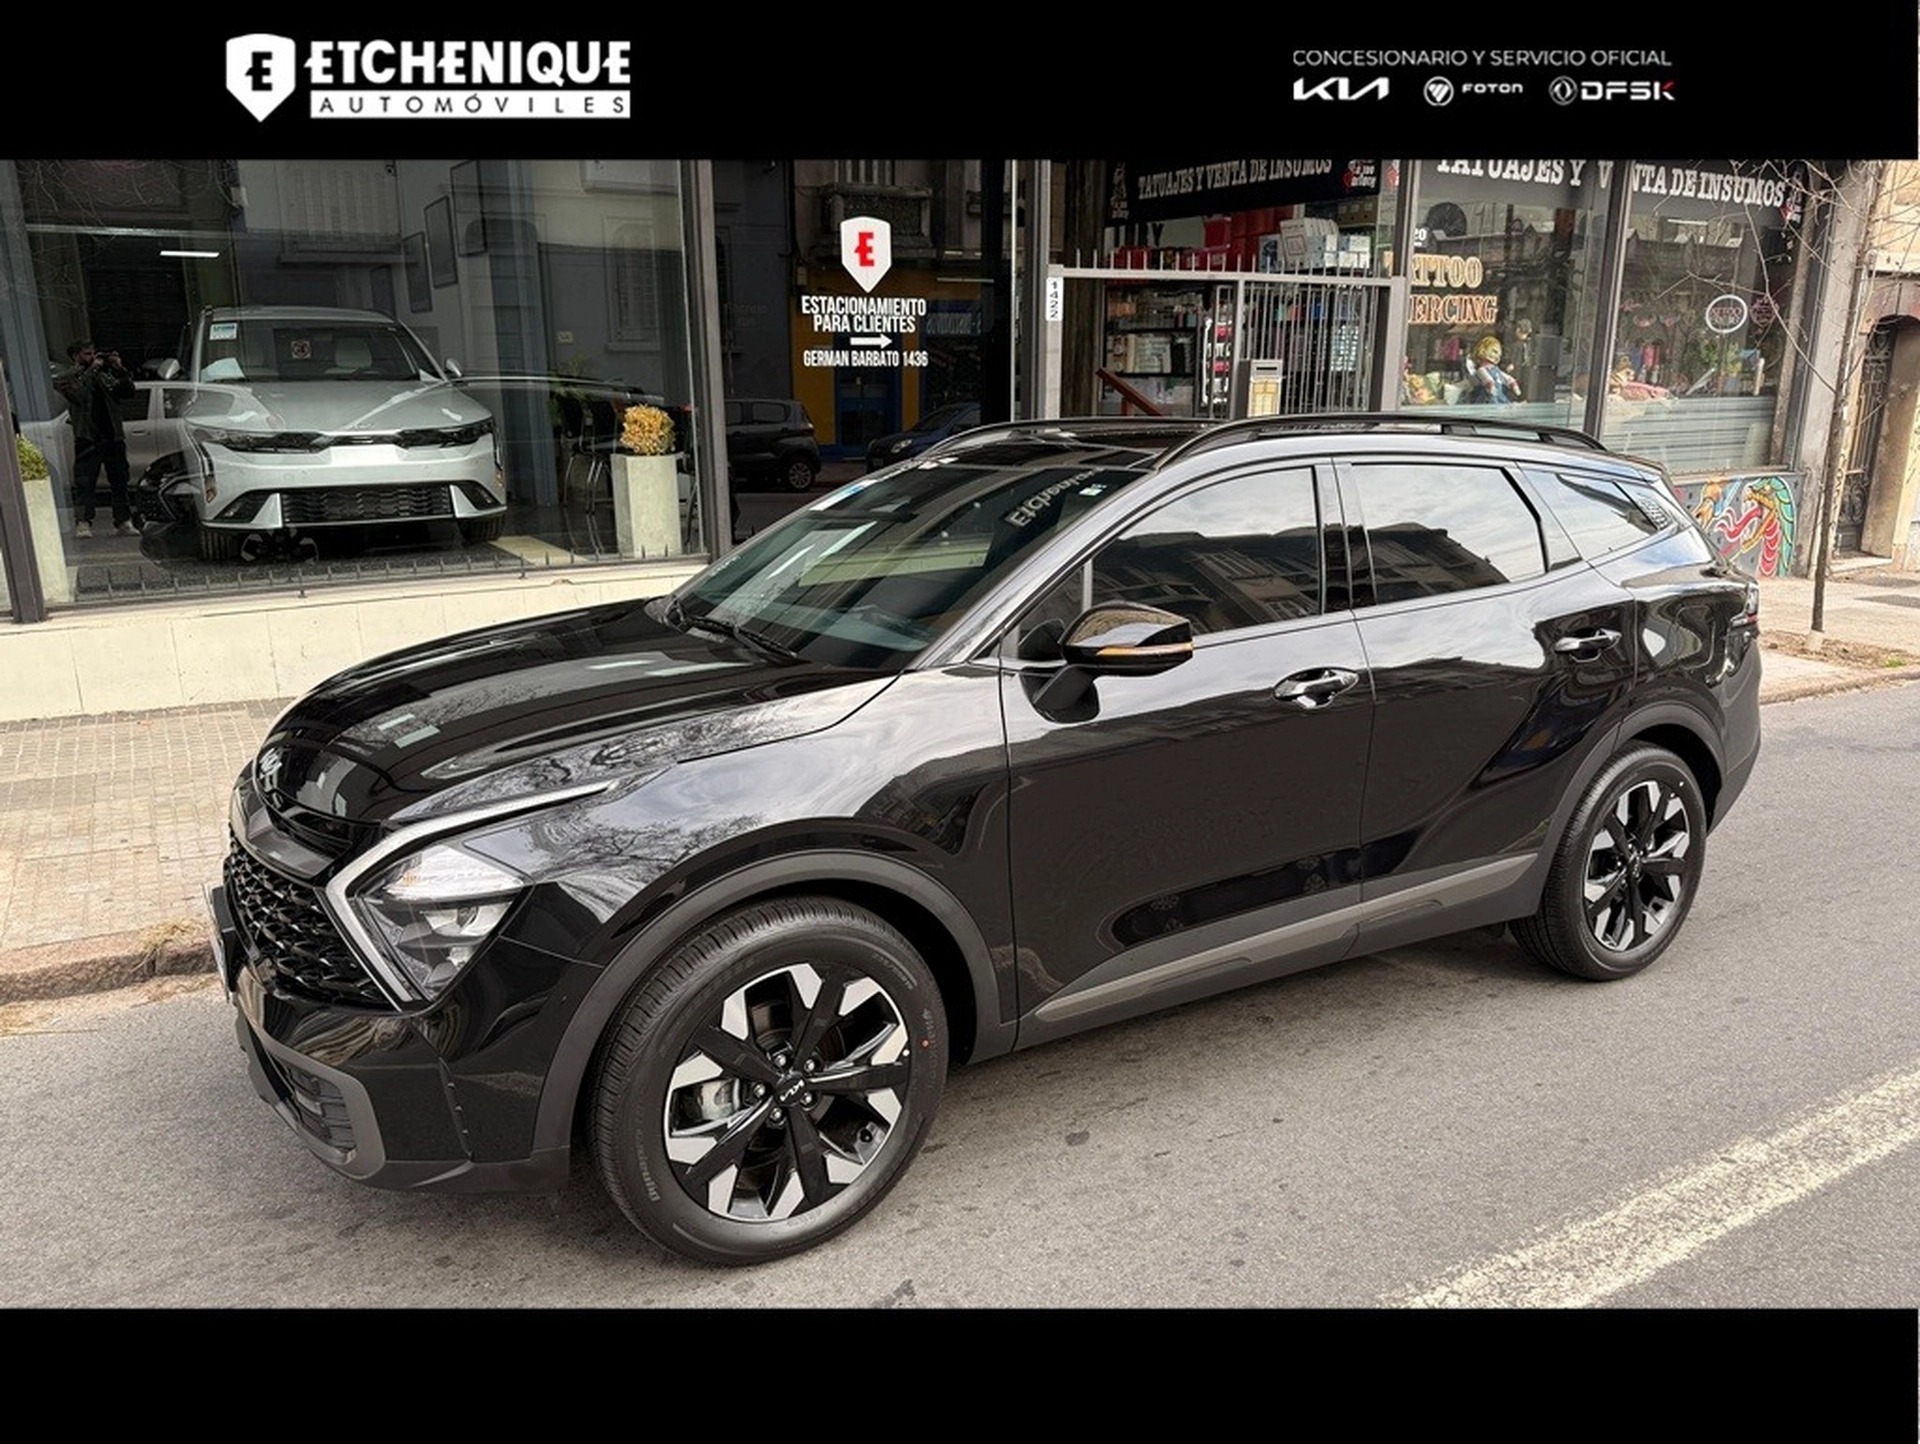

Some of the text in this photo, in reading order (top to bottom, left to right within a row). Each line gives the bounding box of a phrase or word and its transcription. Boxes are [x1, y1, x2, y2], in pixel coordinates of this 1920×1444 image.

[1138, 170, 1194, 199] TATUAJES
[1196, 166, 1204, 191] Y
[1206, 160, 1247, 189] VENTA
[1250, 159, 1266, 183] DE
[1569, 159, 1587, 187] Y
[1669, 168, 1697, 198] DE
[1697, 172, 1786, 208] INSUMOS
[801, 295, 927, 316] ESTACIONAMIENTO
[1409, 294, 1498, 324] ERCING
[814, 315, 850, 332] PARA
[854, 315, 916, 333] CLIENTES
[803, 350, 929, 367] GERMAN BARBATO 1436
